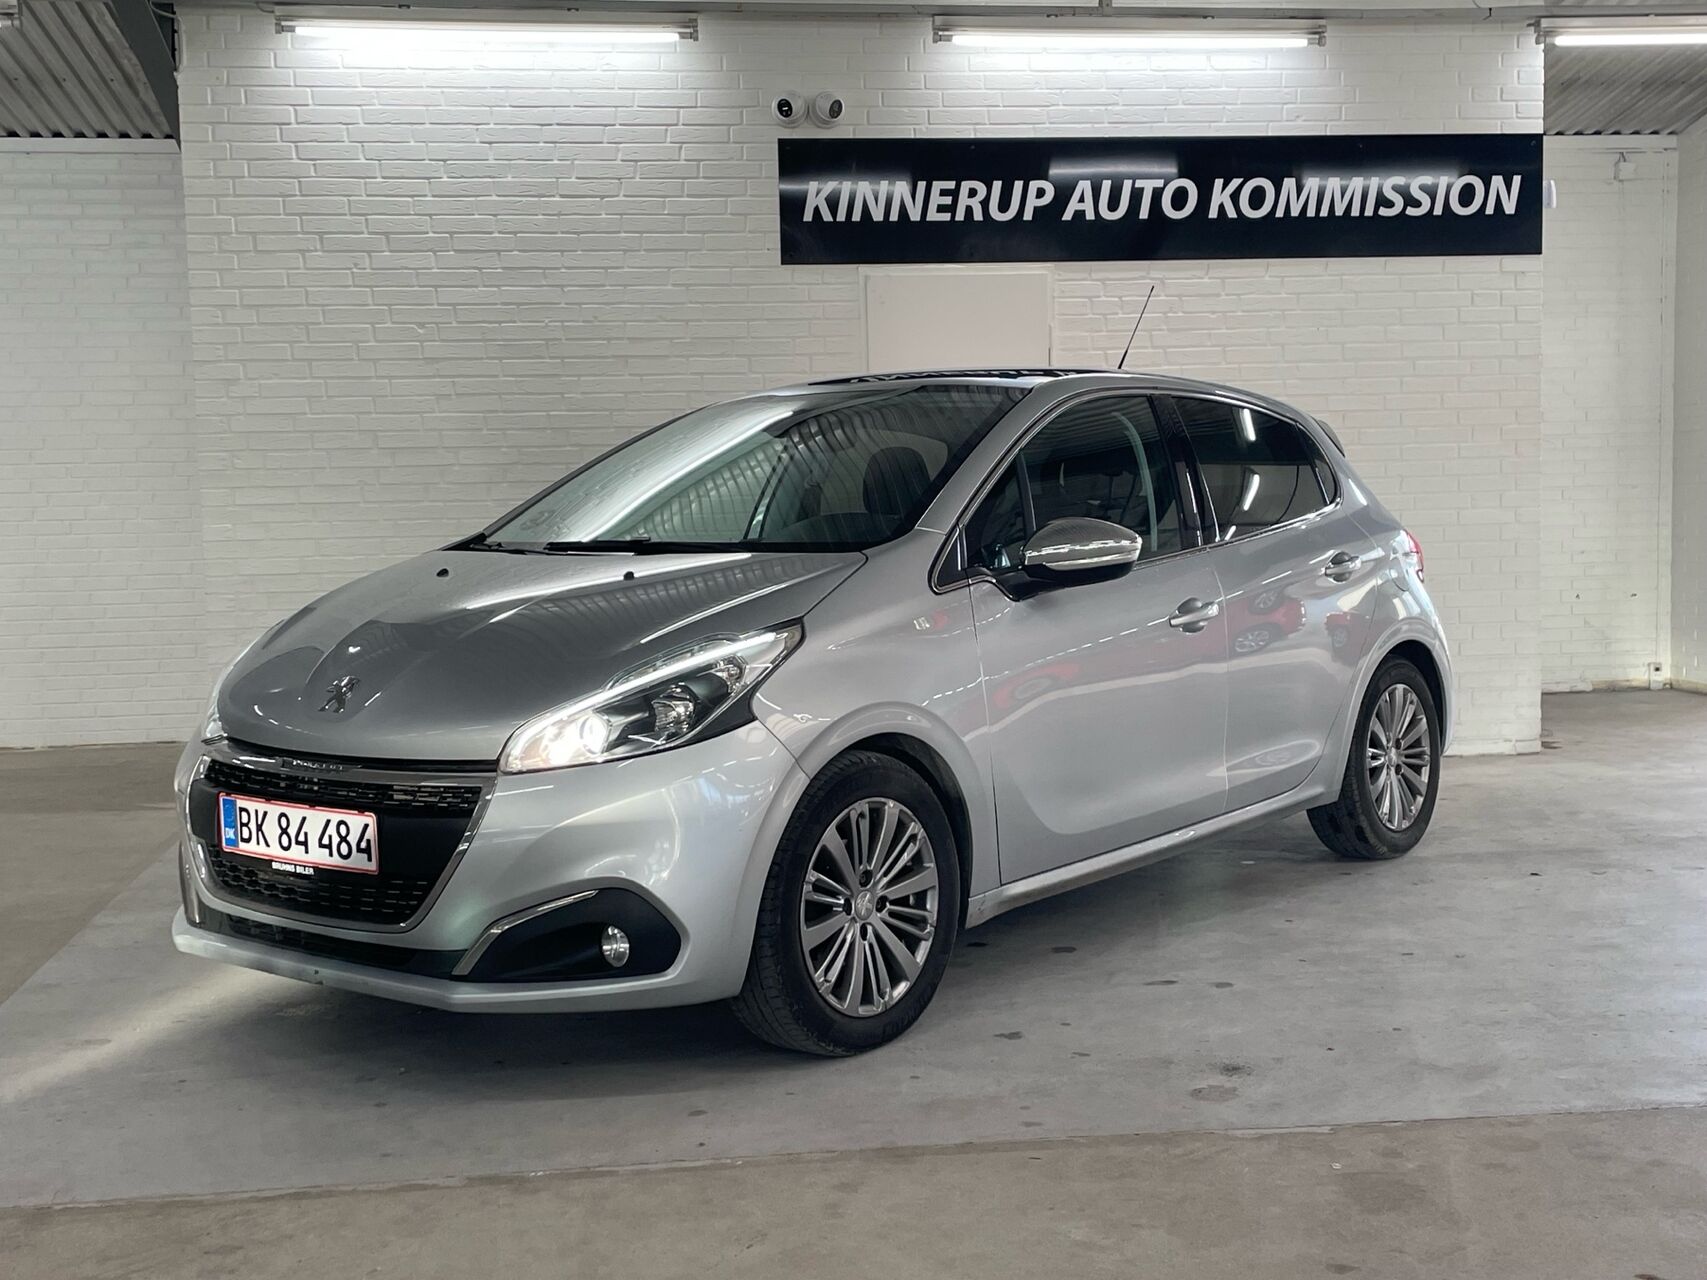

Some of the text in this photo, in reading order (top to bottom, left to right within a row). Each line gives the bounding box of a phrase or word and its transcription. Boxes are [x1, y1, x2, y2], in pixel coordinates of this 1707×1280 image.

[803, 175, 1521, 222] KINNERUP AUTO KOMMISSION
[225, 827, 236, 839] DK
[238, 806, 373, 862] BK 84 484
